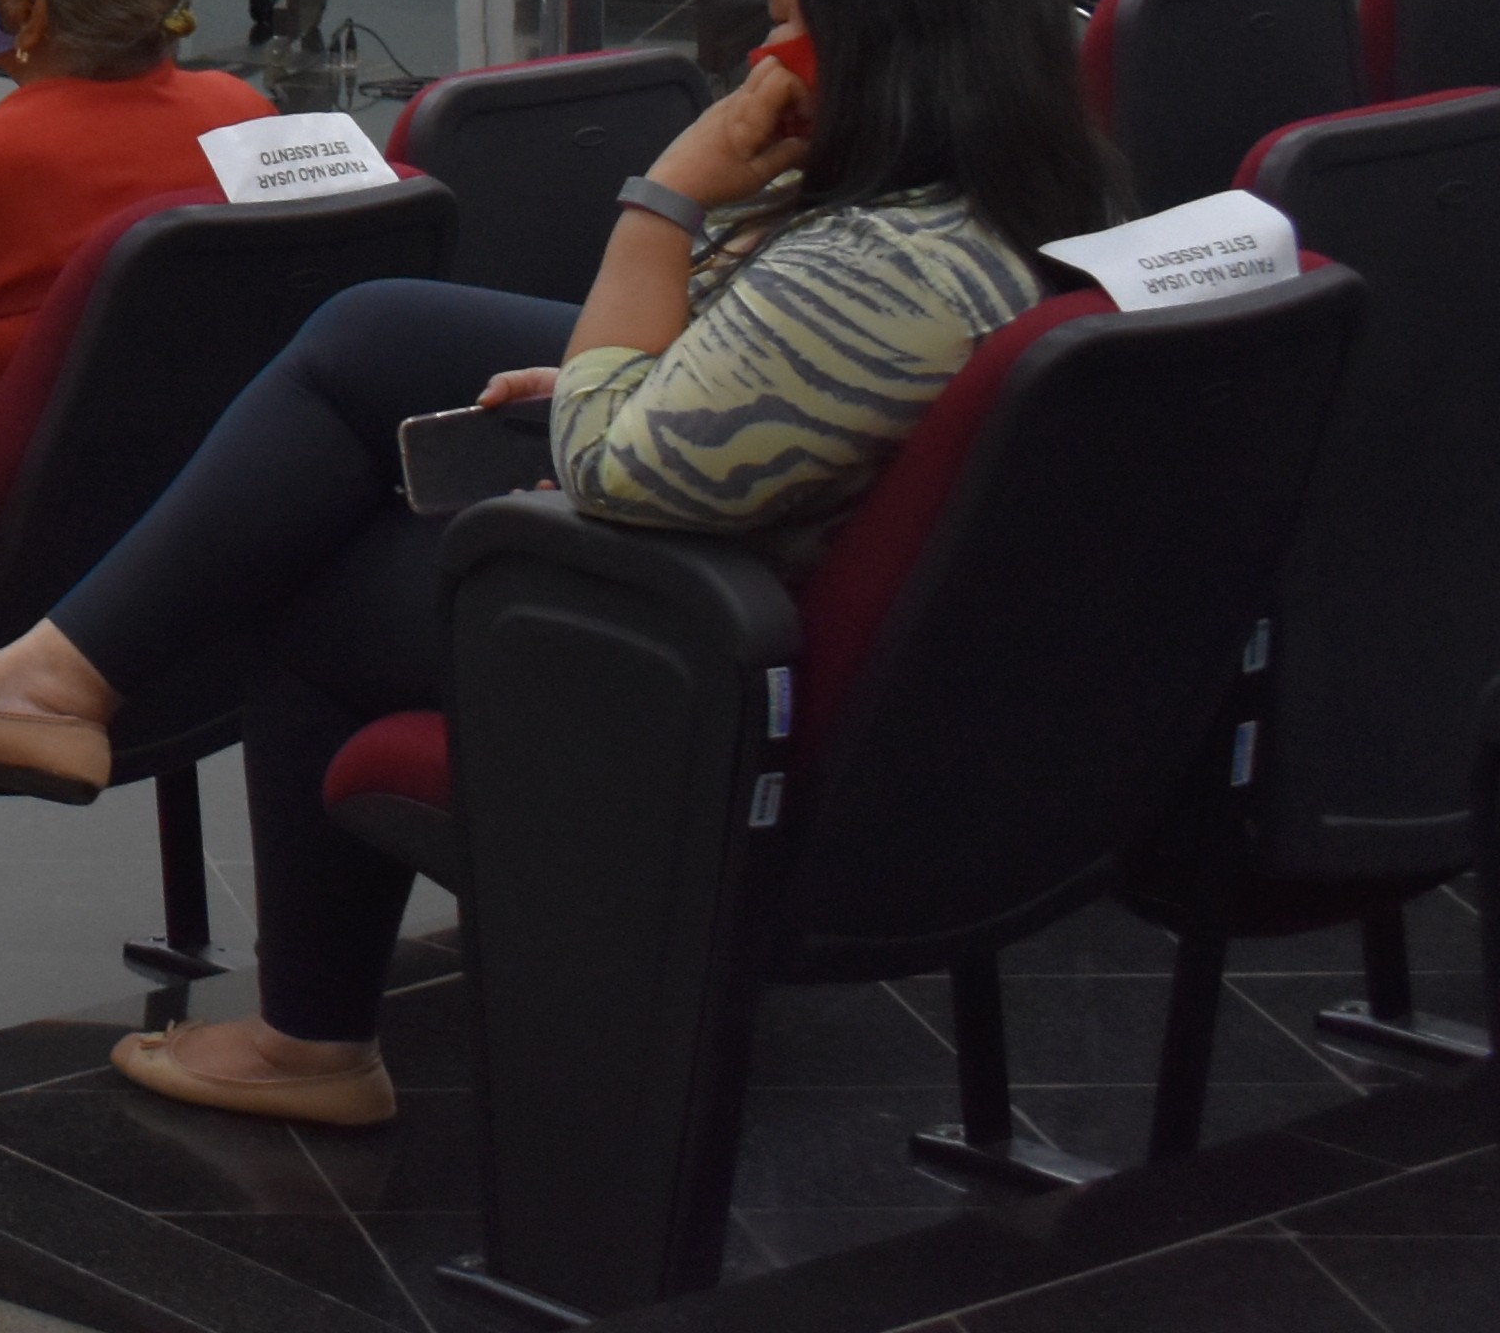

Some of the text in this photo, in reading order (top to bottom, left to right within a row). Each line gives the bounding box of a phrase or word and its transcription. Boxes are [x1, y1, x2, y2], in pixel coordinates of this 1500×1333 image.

[260, 141, 350, 166] ESTE ASSENTO
[257, 160, 369, 189] FAVOR NÃO USAR
[1138, 234, 1257, 270] ESTE ASSENTO
[1142, 256, 1276, 294] FAVOR NÃO USAR
